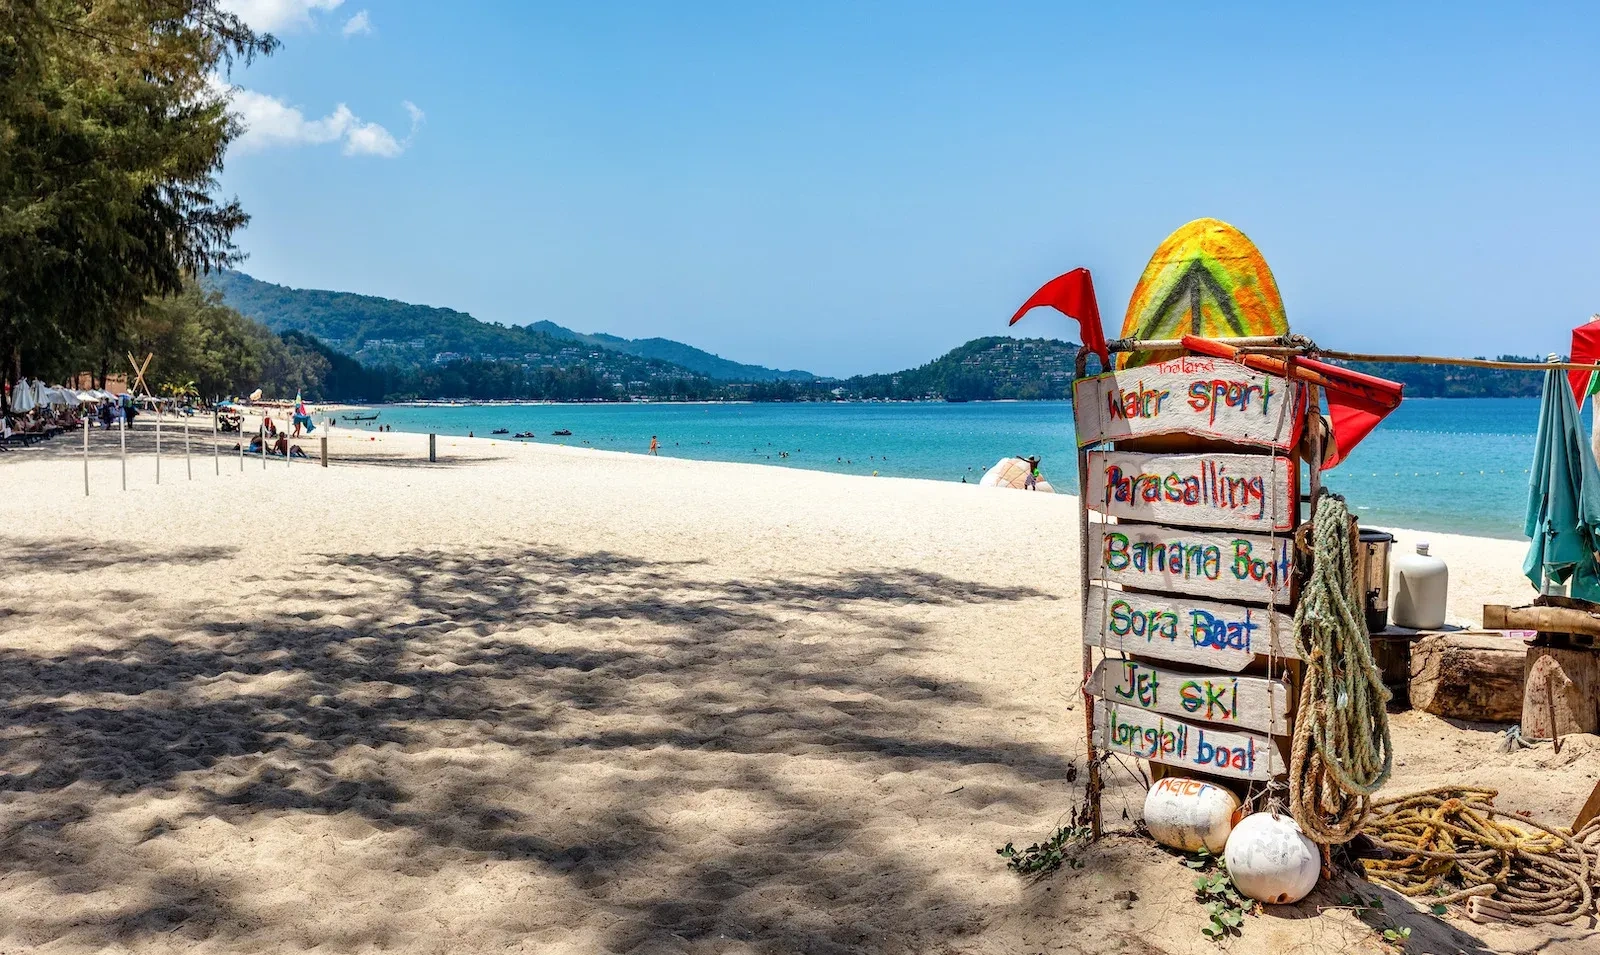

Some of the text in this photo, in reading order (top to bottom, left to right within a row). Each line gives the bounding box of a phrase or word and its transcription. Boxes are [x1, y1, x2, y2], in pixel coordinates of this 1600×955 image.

[1104, 532, 1292, 588] Banana Boat
[1193, 730, 1256, 774] boat
